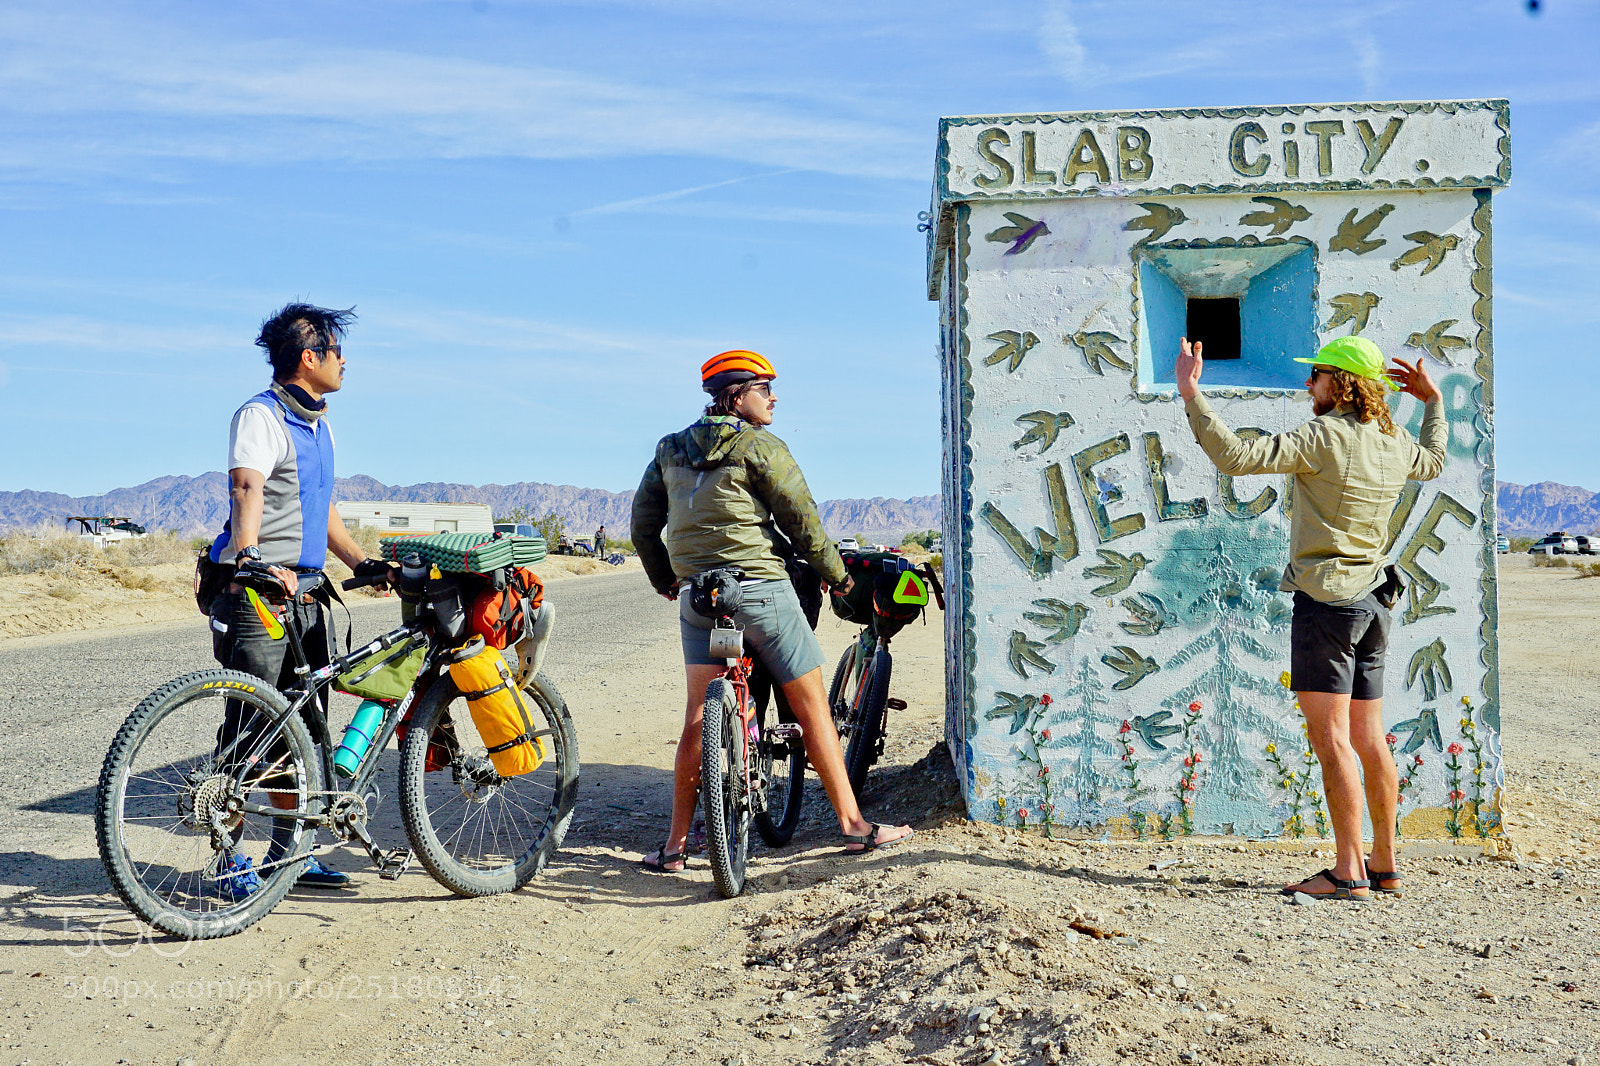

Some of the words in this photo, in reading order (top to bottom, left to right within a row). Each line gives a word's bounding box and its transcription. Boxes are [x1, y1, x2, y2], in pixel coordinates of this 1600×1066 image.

[975, 126, 1154, 188] SLAB
[979, 426, 1478, 593] WELCE
[201, 681, 256, 693] MAXXIS
